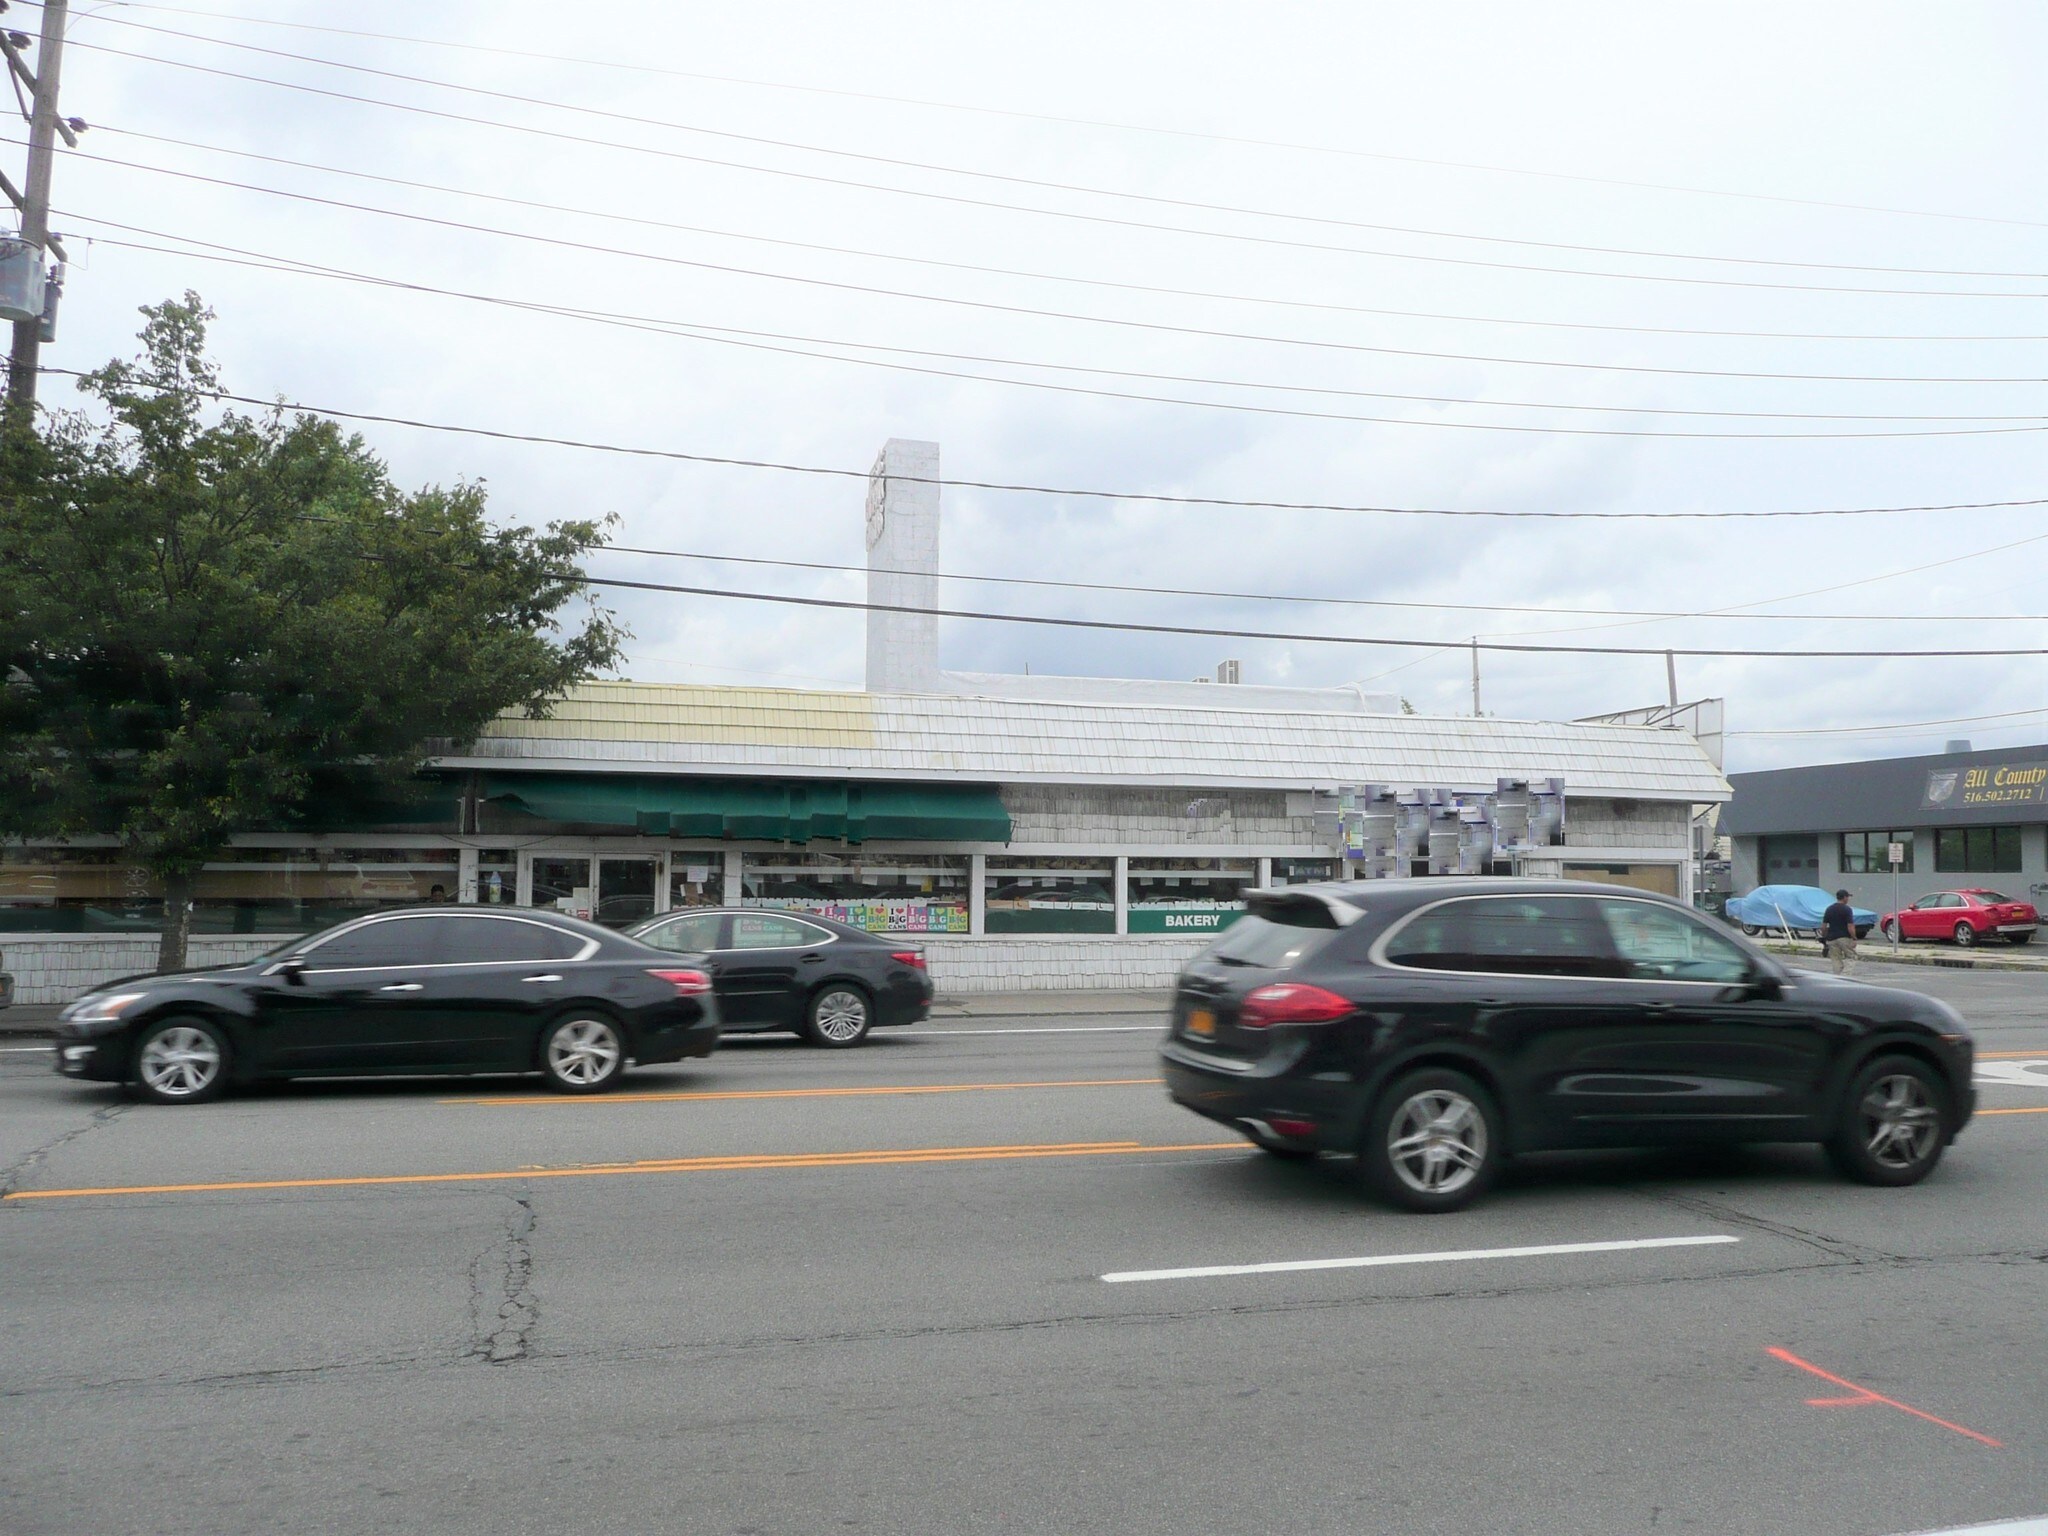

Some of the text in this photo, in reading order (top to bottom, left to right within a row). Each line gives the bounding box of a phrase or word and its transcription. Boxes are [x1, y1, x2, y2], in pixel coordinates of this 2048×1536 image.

[1964, 767, 2046, 788] All County
[1963, 789, 2032, 802] 516.502.2712
[1165, 915, 1220, 927] BAKERY
